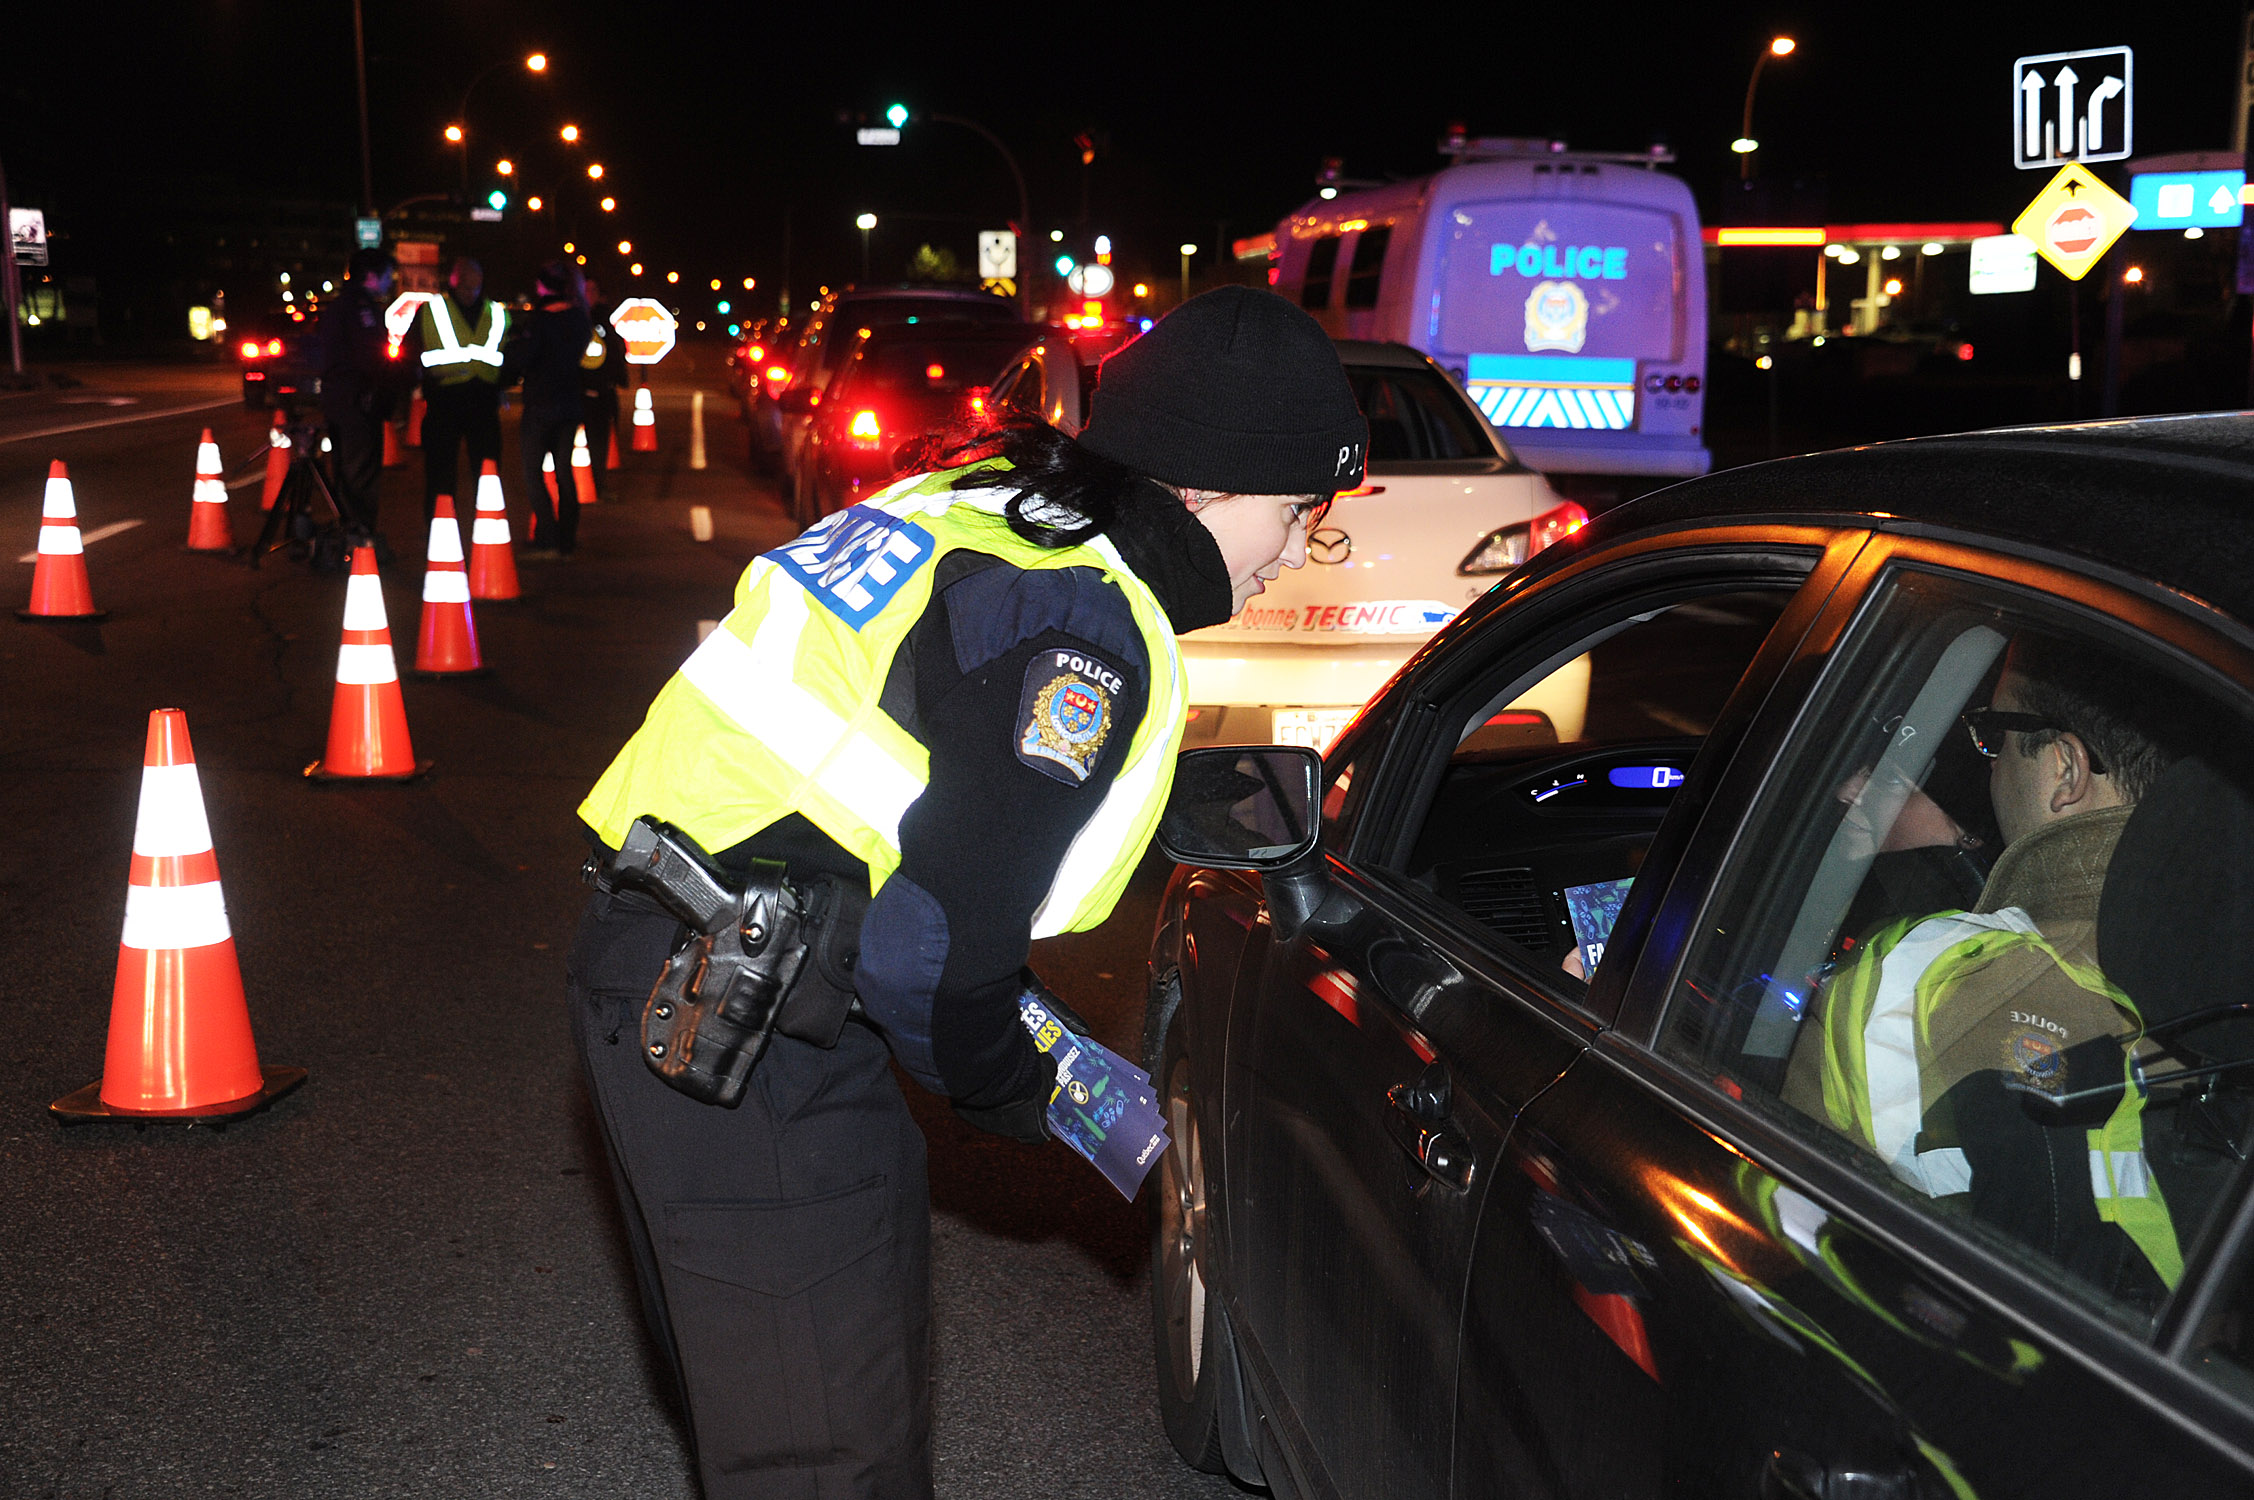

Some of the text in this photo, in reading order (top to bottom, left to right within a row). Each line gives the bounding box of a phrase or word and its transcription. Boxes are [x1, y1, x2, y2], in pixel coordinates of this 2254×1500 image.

[1489, 243, 1629, 280] POLICE
[1242, 604, 1295, 627] bonne
[1303, 605, 1406, 626] TECNIC
[1056, 652, 1122, 695] POLICE
[1652, 766, 1670, 788] 0
[1586, 942, 1605, 966] FA
[1034, 1020, 1062, 1053] LIES
